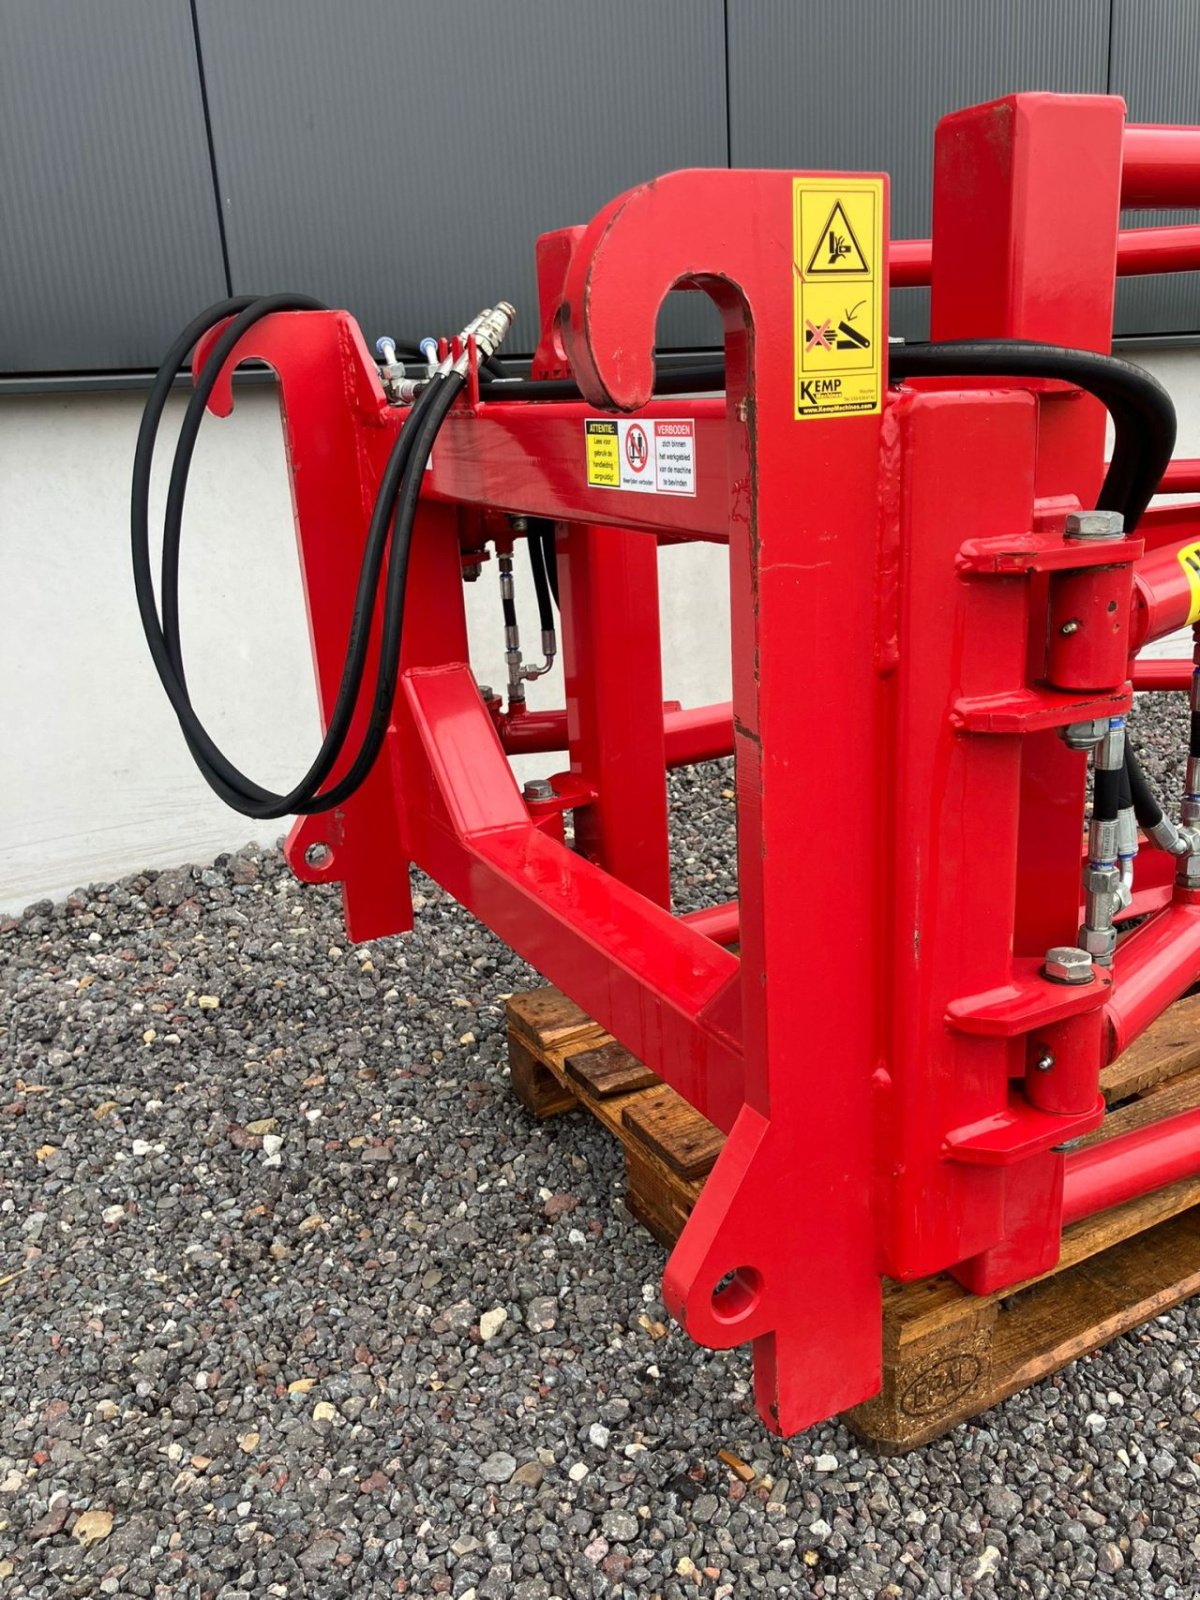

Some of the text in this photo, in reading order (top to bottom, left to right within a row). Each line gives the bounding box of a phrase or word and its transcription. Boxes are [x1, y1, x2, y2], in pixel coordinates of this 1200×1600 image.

[800, 379, 842, 404] KEMP
[803, 404, 873, 414] www.KempMachines.com
[589, 423, 615, 434] ATTENTIE:
[657, 424, 691, 435] VERBODEN
[666, 453, 691, 462] werkgebied
[673, 466, 692, 474] machine
